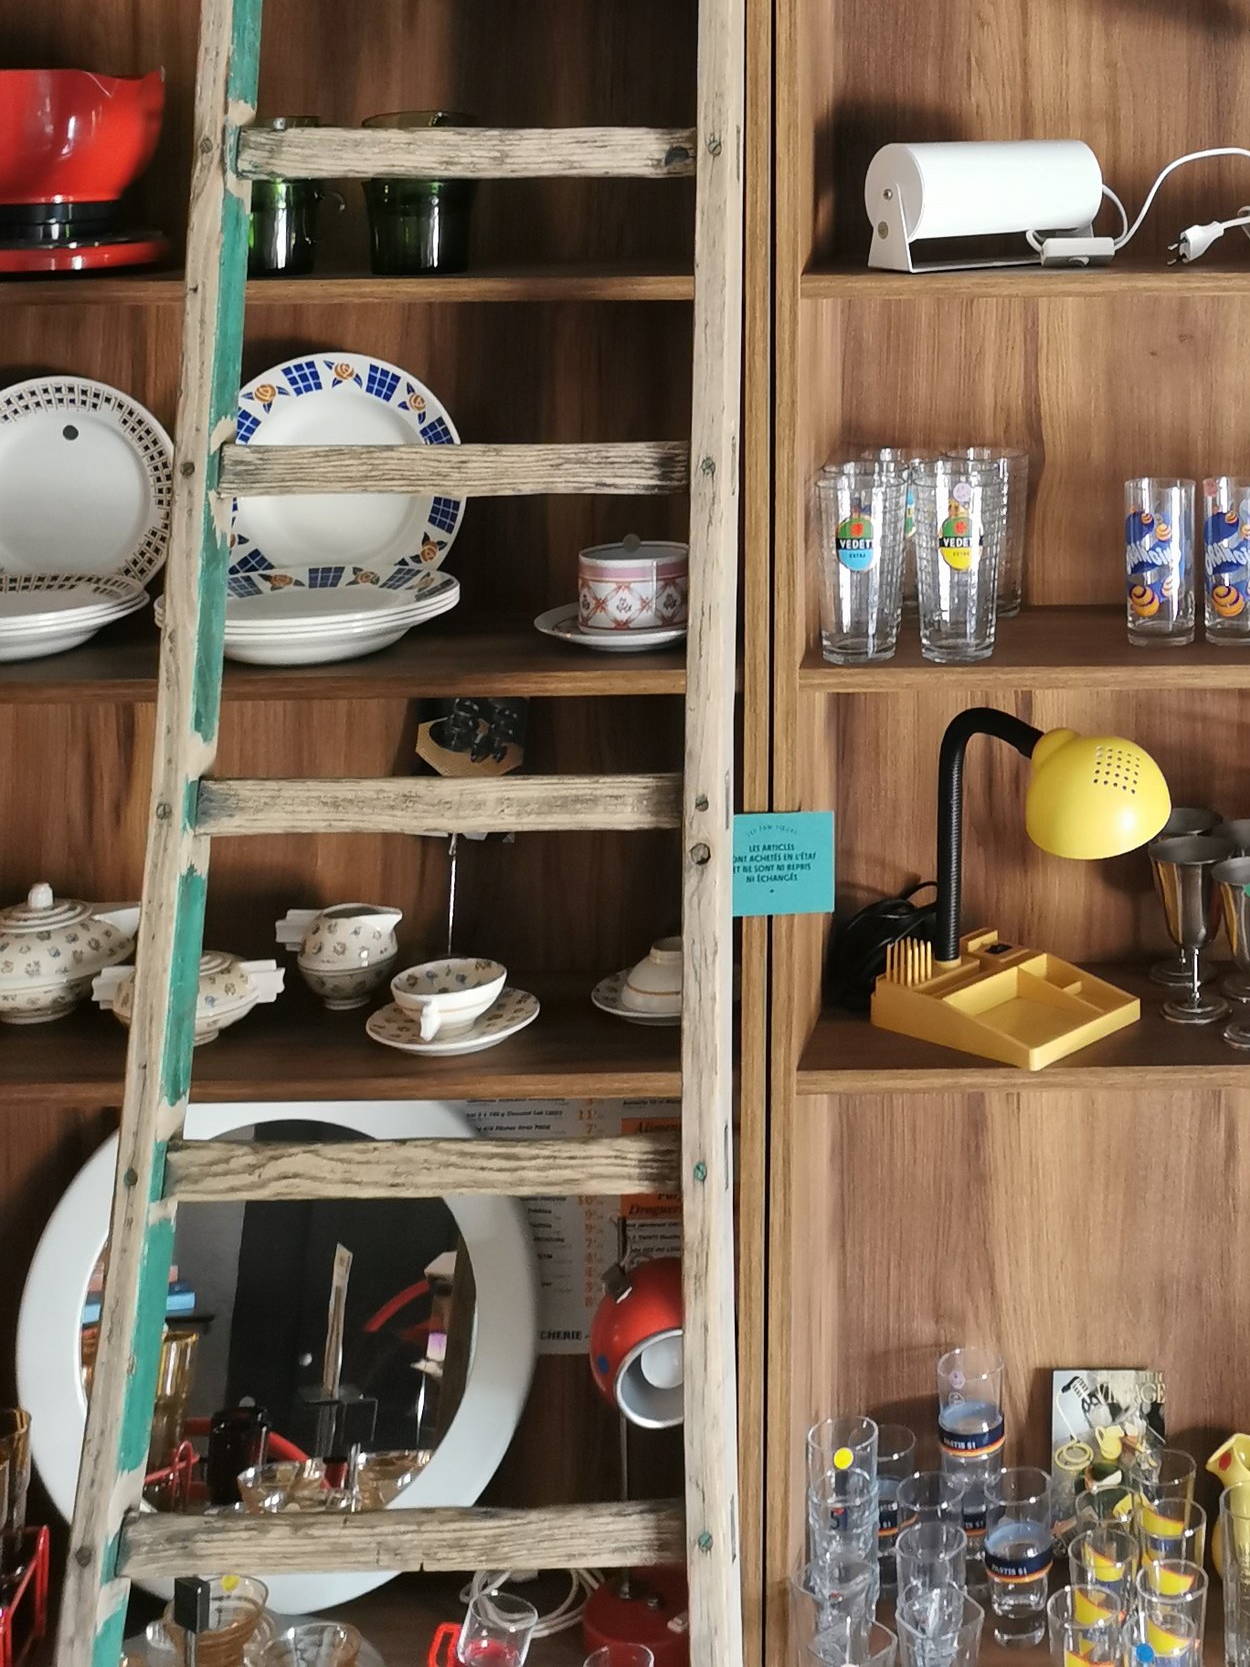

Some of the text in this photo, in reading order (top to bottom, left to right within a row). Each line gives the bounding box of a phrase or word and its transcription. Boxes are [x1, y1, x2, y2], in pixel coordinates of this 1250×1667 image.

[749, 853, 781, 862] ACHETÉS
[796, 852, 816, 860] L'ÉTAT
[742, 865, 752, 873] NE
[787, 863, 811, 871] REPRIS
